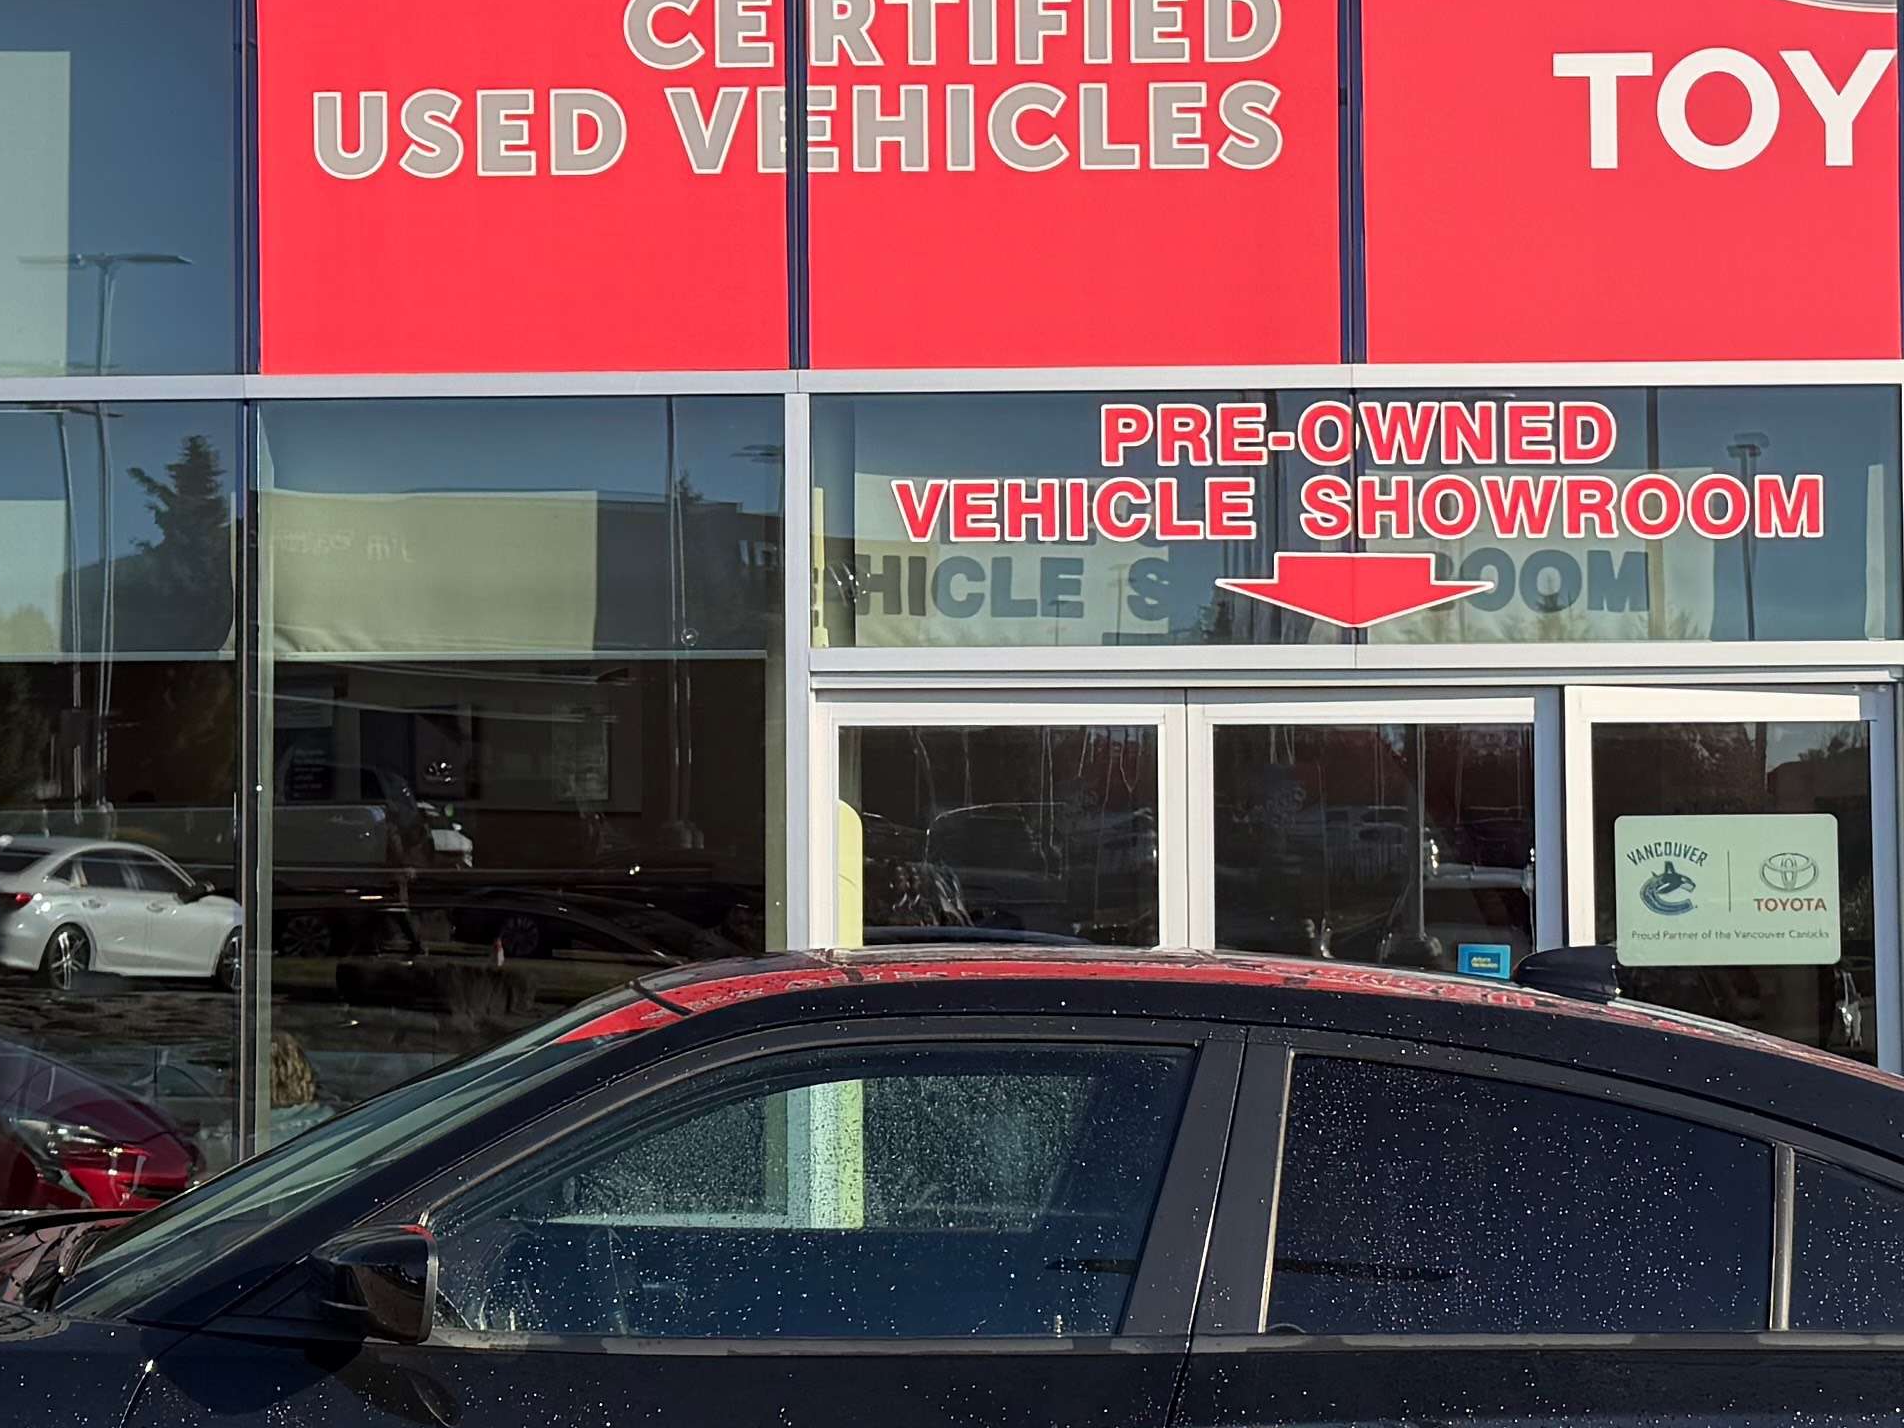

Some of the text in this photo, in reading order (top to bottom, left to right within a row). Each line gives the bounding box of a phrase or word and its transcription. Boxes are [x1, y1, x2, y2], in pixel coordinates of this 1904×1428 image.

[312, 79, 1284, 178] USED VEHICLES
[1100, 400, 1616, 467] PRE-OWNED
[892, 473, 1825, 543] VEHICLE SHOWROOM
[1627, 841, 1708, 867] VANCOUVER
[1753, 897, 1827, 912] TOYOTA
[1631, 928, 1830, 941] Proud Partner of the Vancouver Canucks
